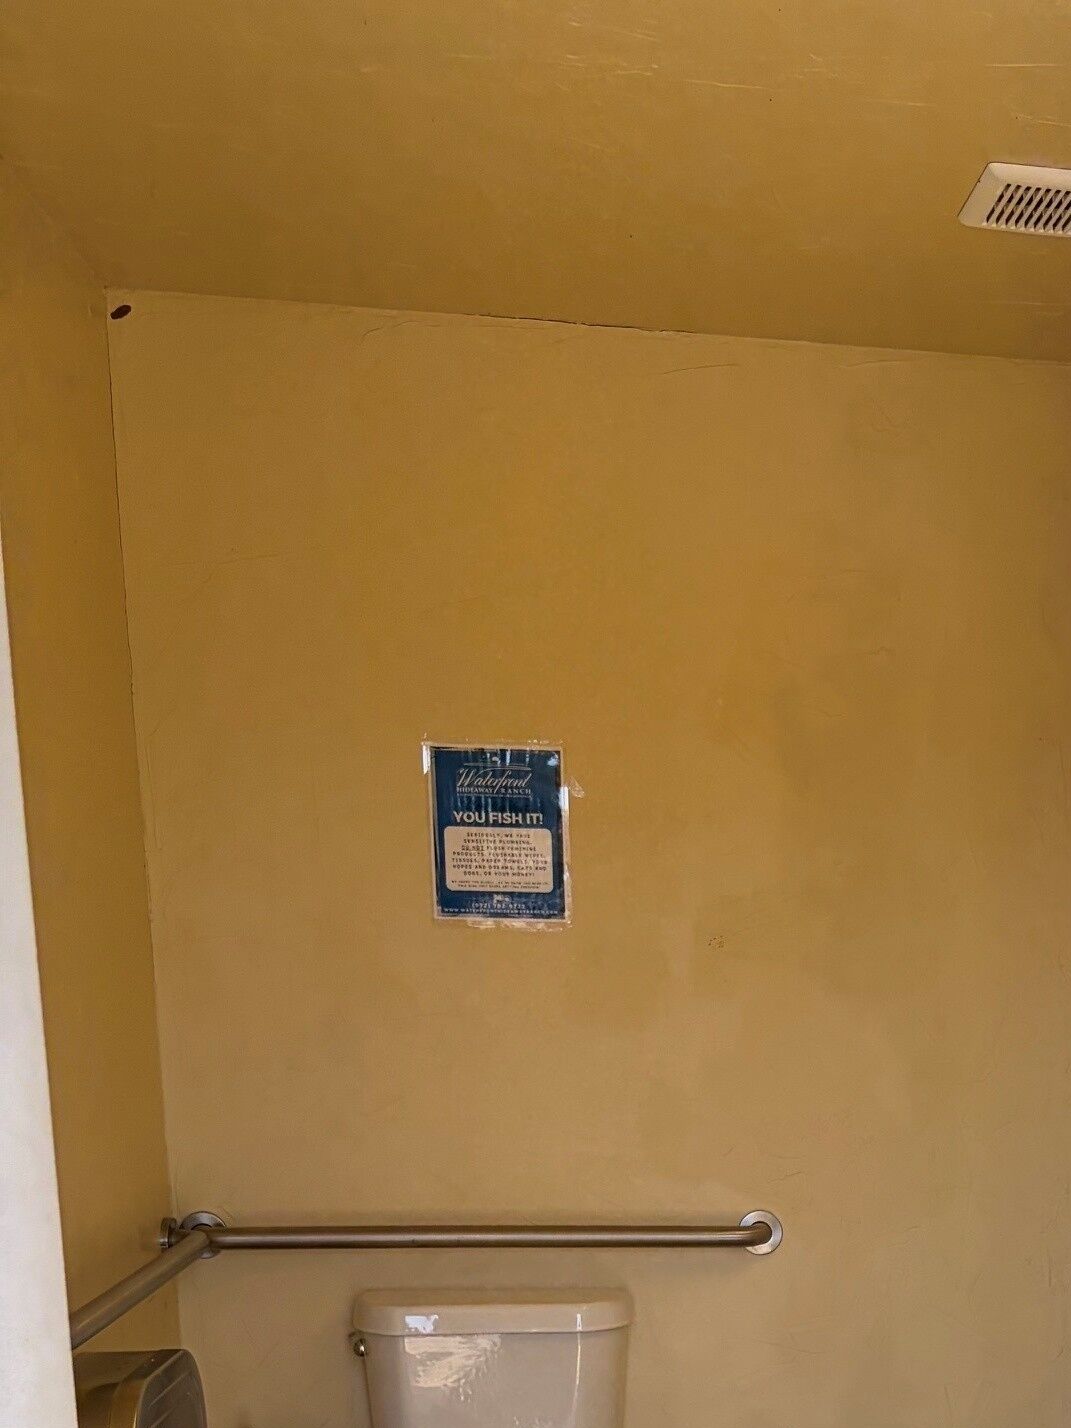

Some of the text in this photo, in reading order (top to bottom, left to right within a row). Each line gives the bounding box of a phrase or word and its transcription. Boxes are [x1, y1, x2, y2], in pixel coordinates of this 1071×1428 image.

[456, 768, 532, 794] Waterfront
[452, 810, 544, 825] YOU FISH IT!
